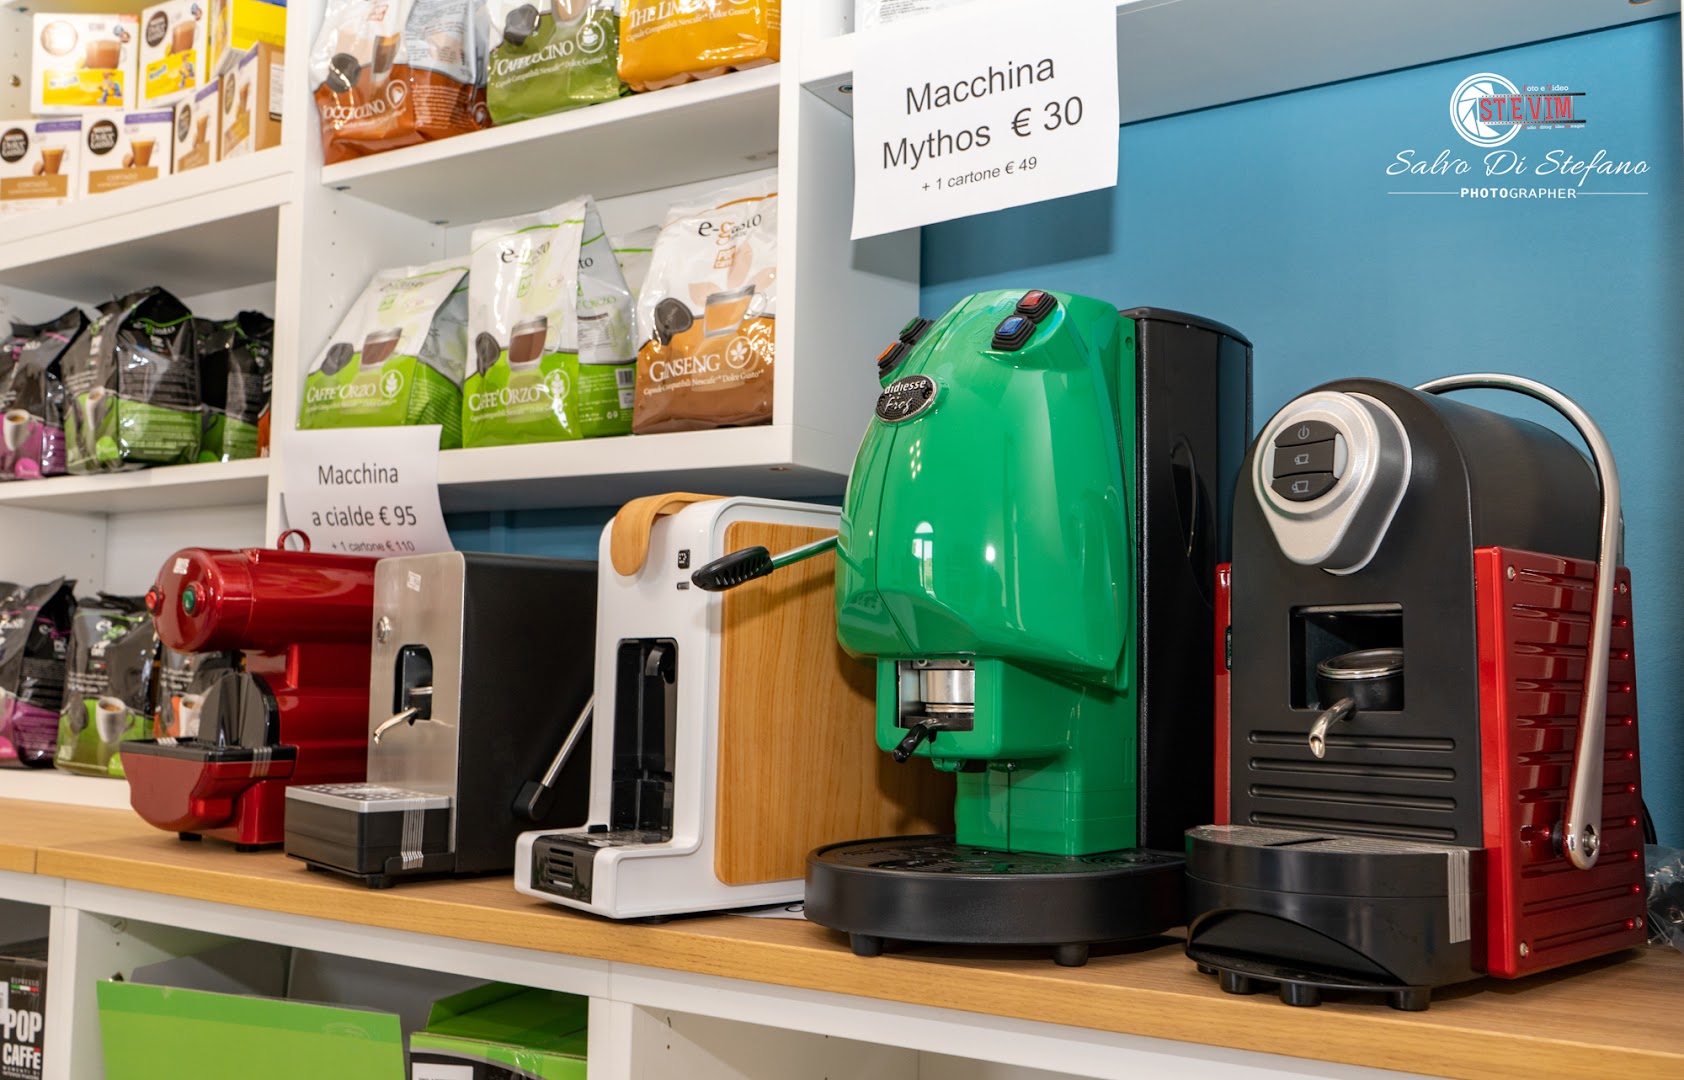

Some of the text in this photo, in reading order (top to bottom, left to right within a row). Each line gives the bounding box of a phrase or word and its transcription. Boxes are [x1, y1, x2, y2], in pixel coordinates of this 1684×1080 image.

[630, 4, 657, 30] THE
[906, 57, 1055, 115] Macchina
[883, 96, 1083, 170] Mythos € 30
[922, 156, 1038, 191] + 1 cartone € 49
[649, 353, 720, 382] GINSENG
[884, 379, 927, 397] didiesse
[318, 462, 399, 485] Macchina
[312, 505, 417, 527] a cialde € 95
[341, 541, 346, 551] 1
[349, 541, 386, 552] cartone
[385, 540, 395, 551] €
[395, 540, 415, 551] 110
[3, 1008, 42, 1044] POP
